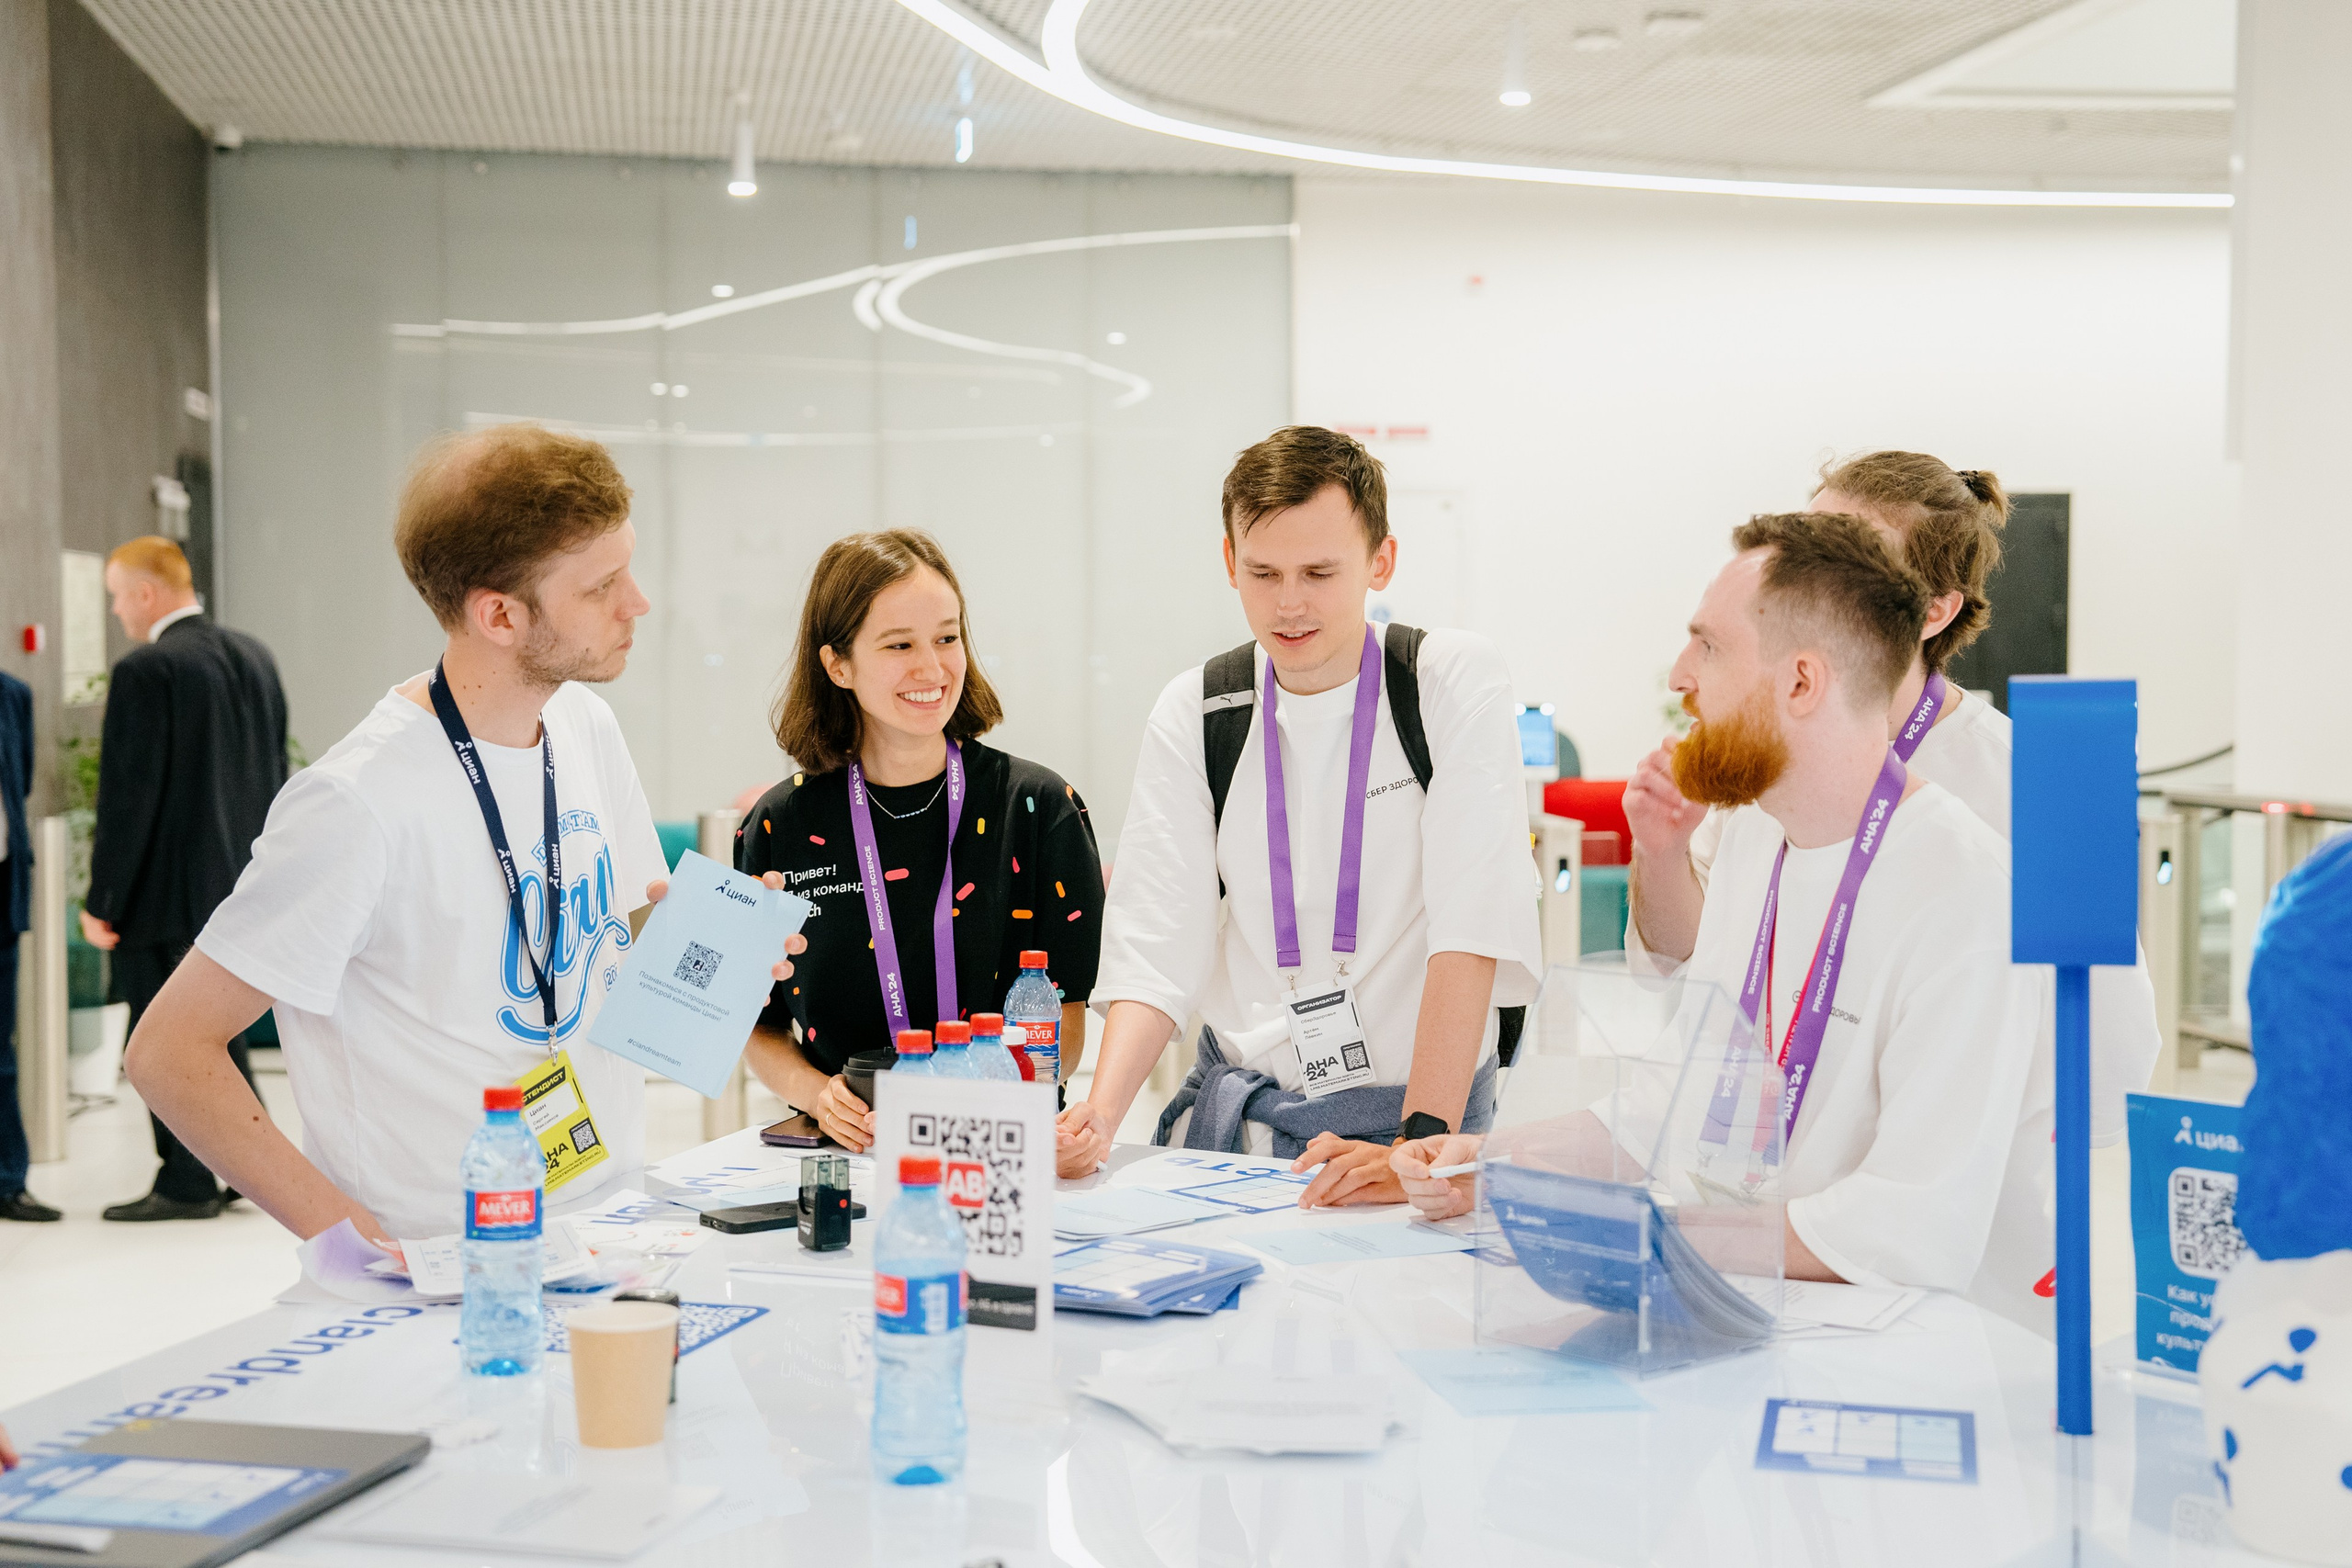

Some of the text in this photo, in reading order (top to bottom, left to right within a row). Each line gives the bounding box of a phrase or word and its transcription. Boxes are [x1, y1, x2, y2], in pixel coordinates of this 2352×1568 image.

[460, 751, 481, 784] циан
[1365, 776, 1419, 799] СБЕР ЗДОРО
[1860, 798, 1890, 854] AHA'24
[552, 843, 561, 877] циан
[782, 863, 837, 886] Привет!
[503, 861, 516, 894] циан
[813, 882, 865, 898] команд
[864, 844, 886, 931] PRODUCT SCIENCE
[726, 889, 757, 908] циан
[1812, 902, 1848, 1013] PRODUCT SCIENCE
[639, 970, 682, 996] Познакомься
[688, 992, 730, 1017] продуктовой
[639, 981, 722, 1022] культурой команды Циан!
[888, 972, 903, 1018] AHA'24
[1297, 995, 1342, 1010] ОРГАНИЗАТОР
[628, 1038, 682, 1067] #ciandreamteam
[1306, 1055, 1339, 1073] AHA
[1783, 1064, 1806, 1121] AHA'24
[2195, 1130, 2245, 1153] циа
